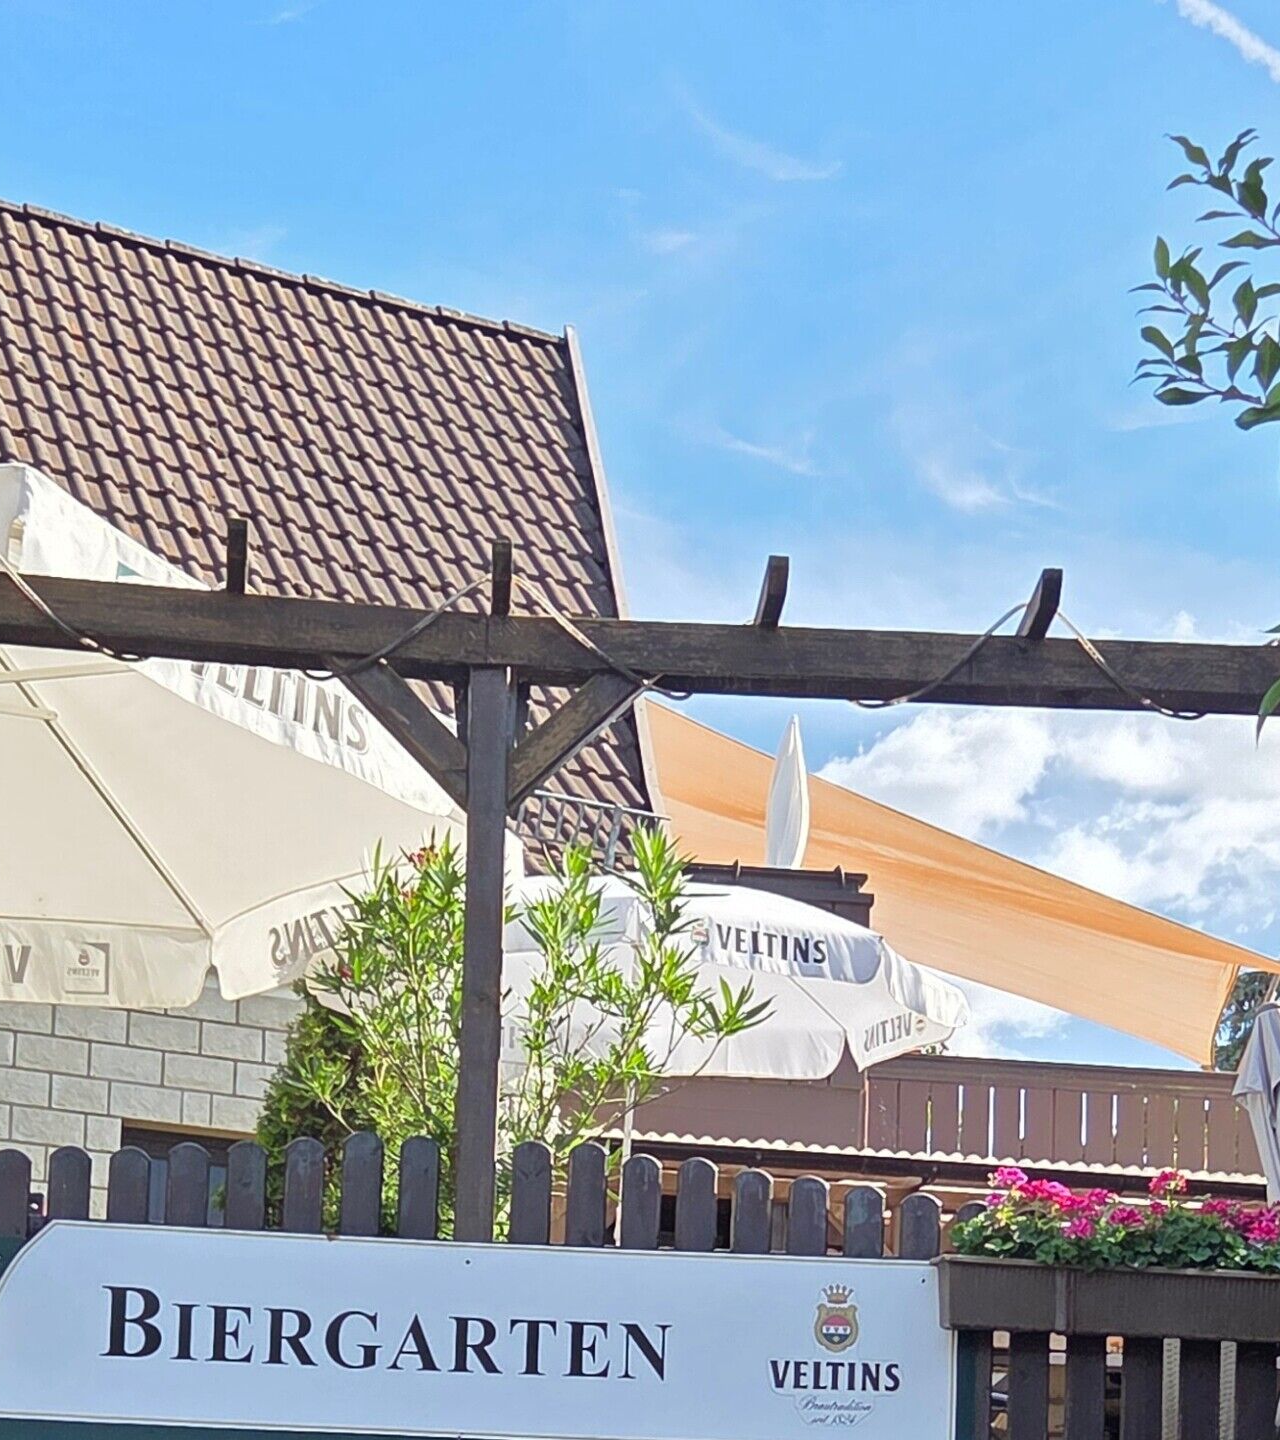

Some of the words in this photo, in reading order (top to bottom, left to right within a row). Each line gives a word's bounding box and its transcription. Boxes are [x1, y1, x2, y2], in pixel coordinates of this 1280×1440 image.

[717, 923, 827, 964] VELTINS
[98, 1284, 673, 1382] BIERGARTEN
[770, 1359, 901, 1392] VELTINS
